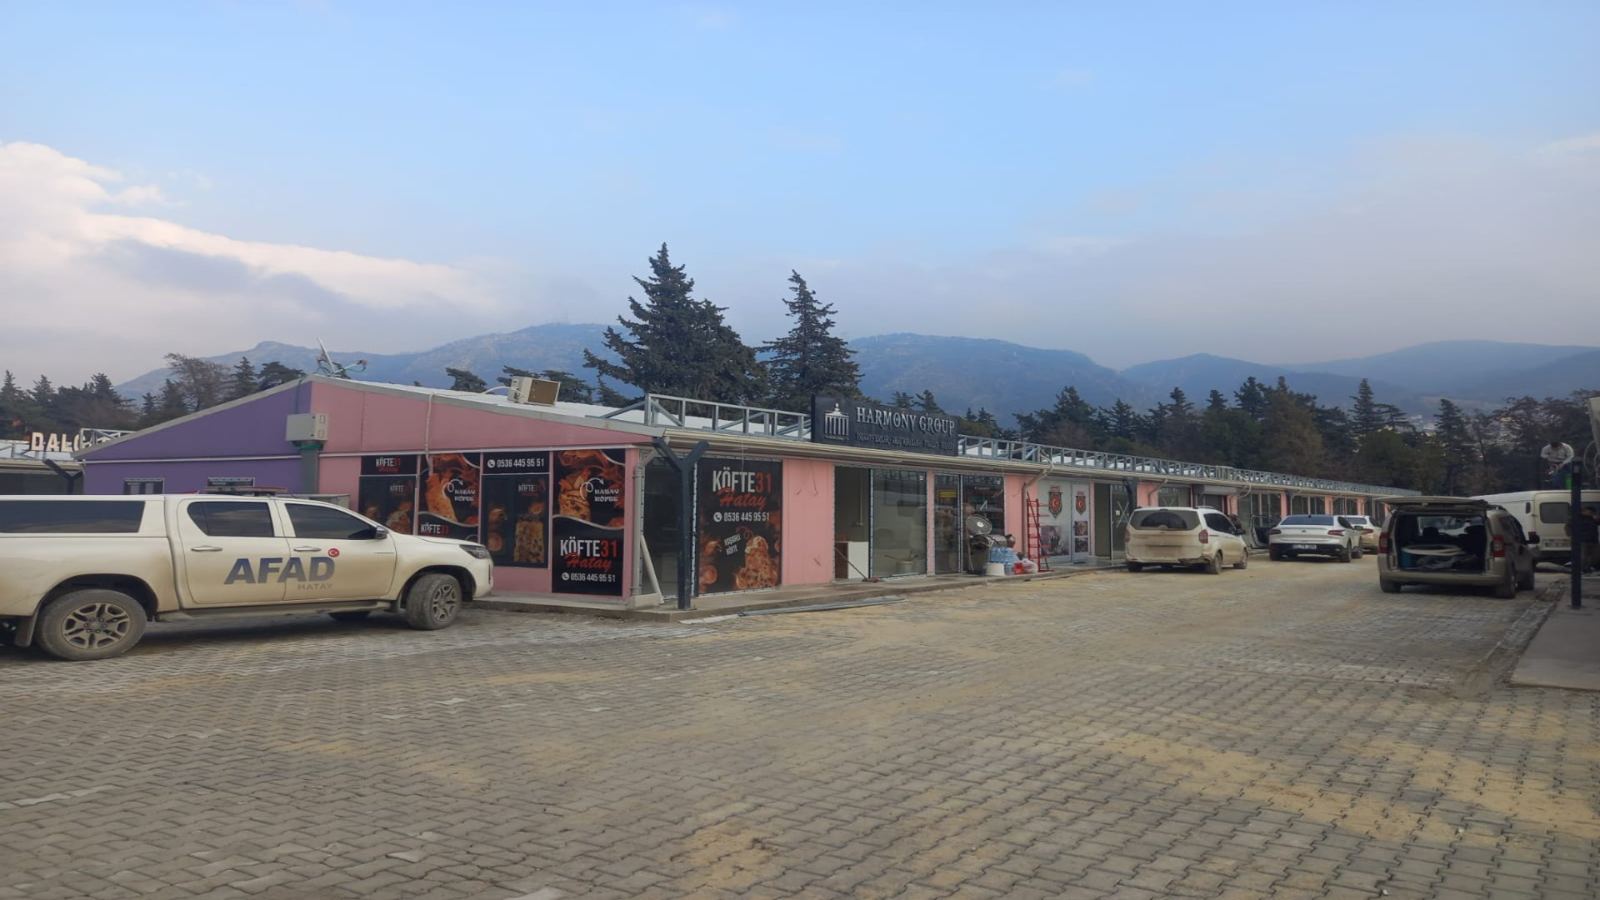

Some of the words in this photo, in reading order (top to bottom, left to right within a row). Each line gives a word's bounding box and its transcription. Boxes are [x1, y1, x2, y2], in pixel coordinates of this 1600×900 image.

[856, 406, 917, 431] HARMONY
[919, 415, 956, 435] GROUP
[513, 458, 526, 467] 445
[712, 466, 773, 494] KÖFTE31
[723, 511, 740, 522] 0536
[740, 512, 753, 522] 445
[753, 512, 761, 521] 95
[560, 536, 618, 558] KÖFTE31
[223, 557, 335, 585] AFAD
[586, 573, 598, 582] 445
[298, 583, 333, 591] HATAY
